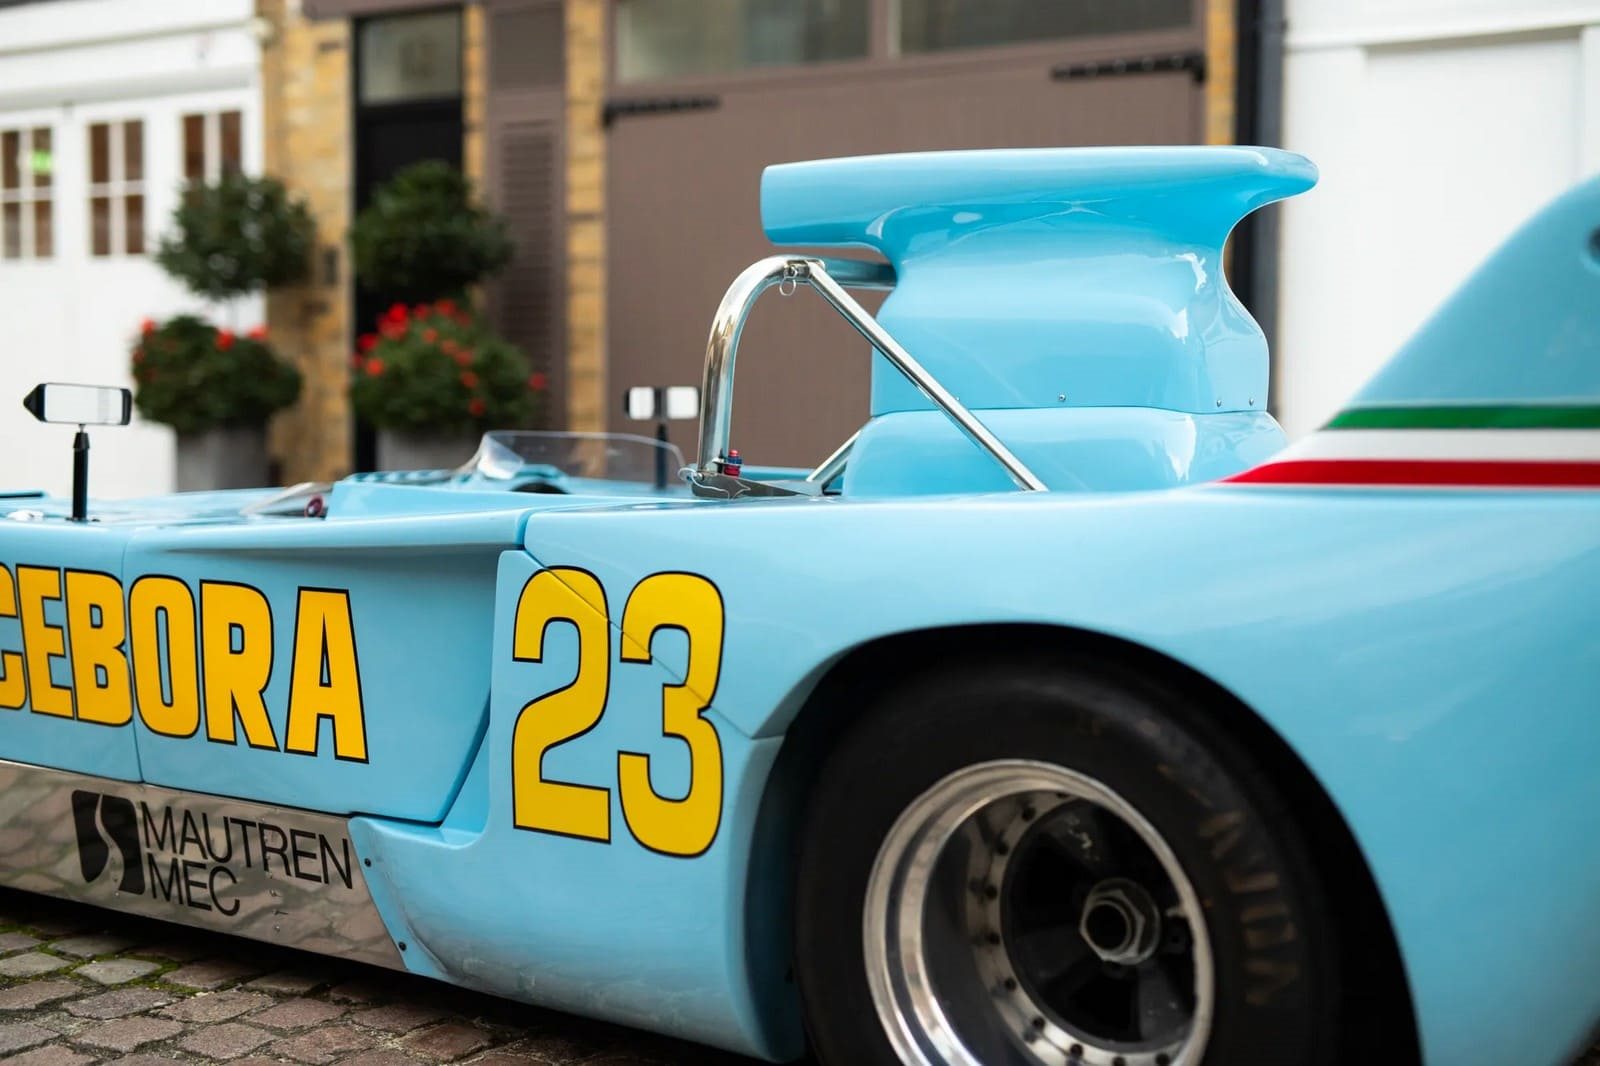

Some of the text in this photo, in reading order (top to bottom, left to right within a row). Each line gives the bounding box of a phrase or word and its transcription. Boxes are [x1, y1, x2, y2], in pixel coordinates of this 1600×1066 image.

[511, 565, 725, 860] 23
[140, 801, 354, 889] MAUTREN
[147, 853, 240, 916] MEC
